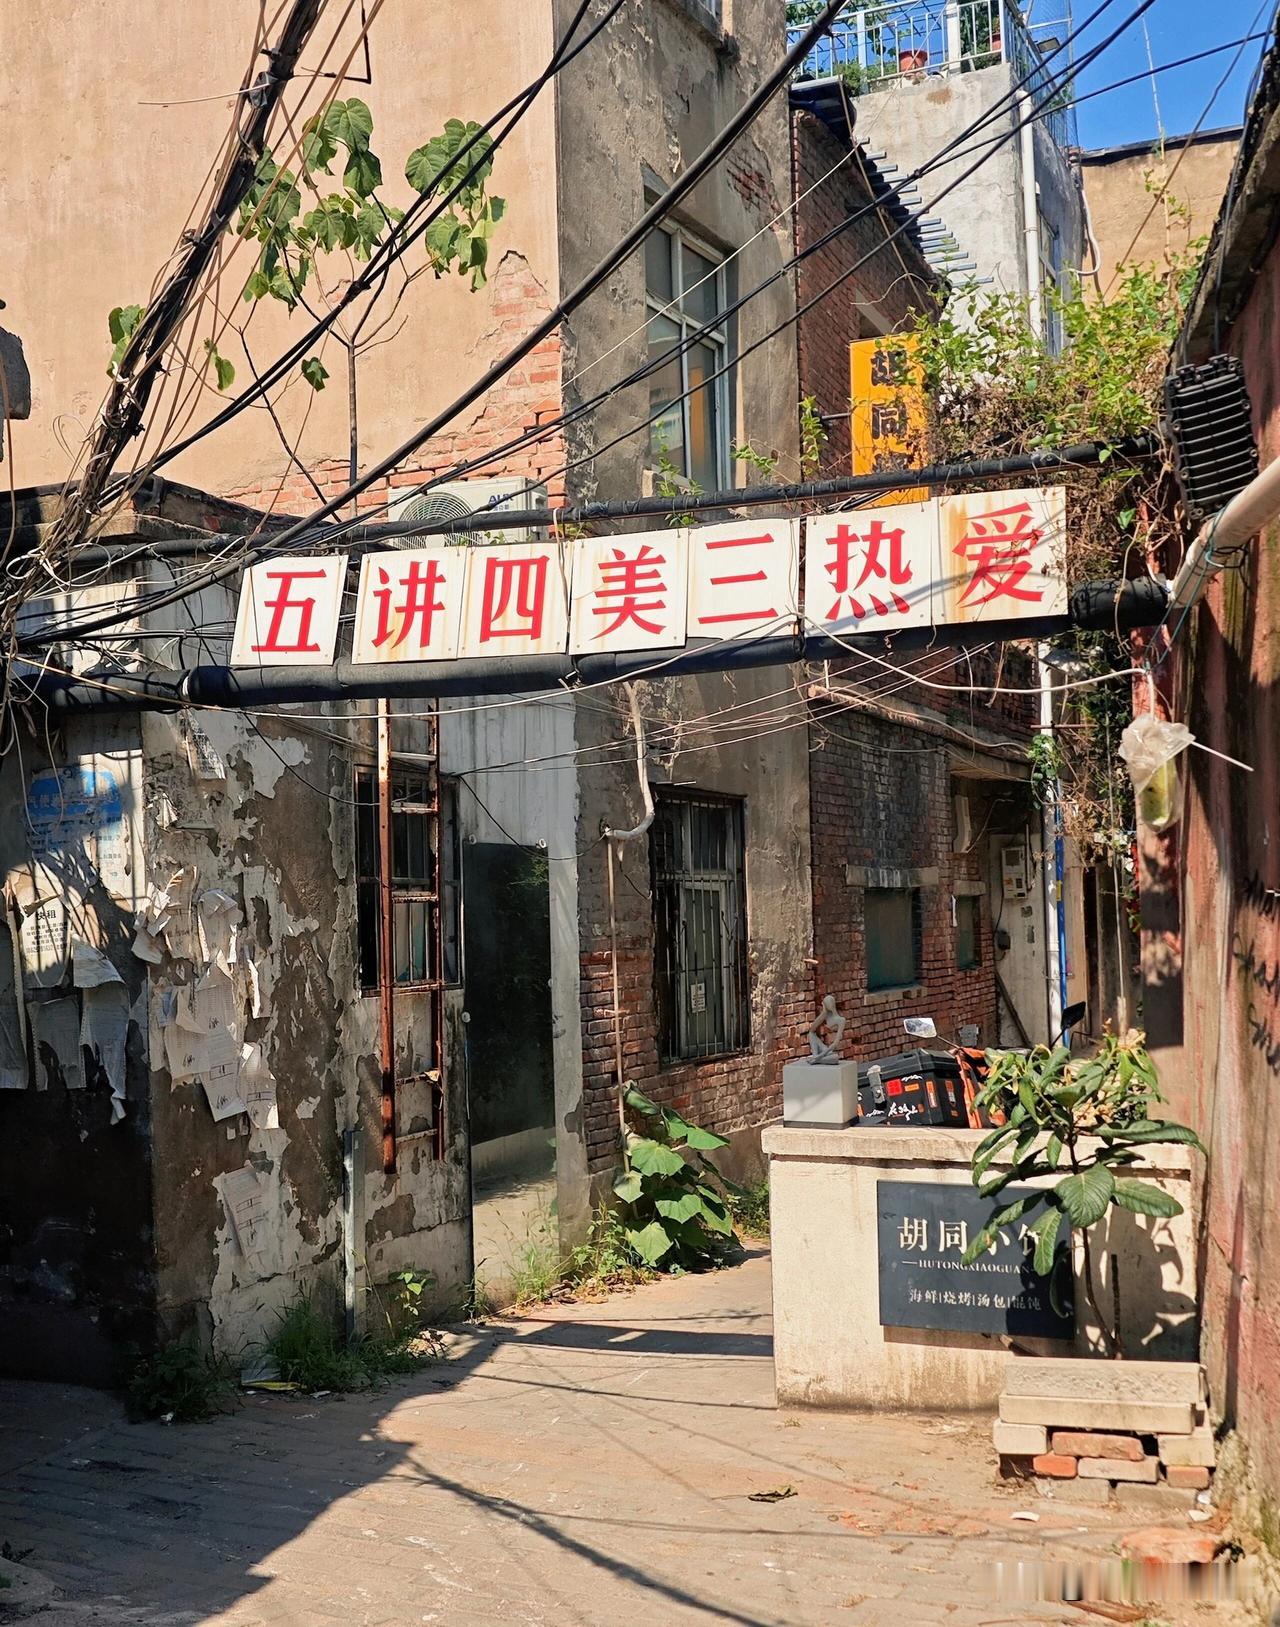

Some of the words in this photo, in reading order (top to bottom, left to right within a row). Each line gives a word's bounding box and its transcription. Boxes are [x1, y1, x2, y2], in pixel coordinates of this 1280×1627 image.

[251, 502, 1045, 652] 五讲四美三热爱
